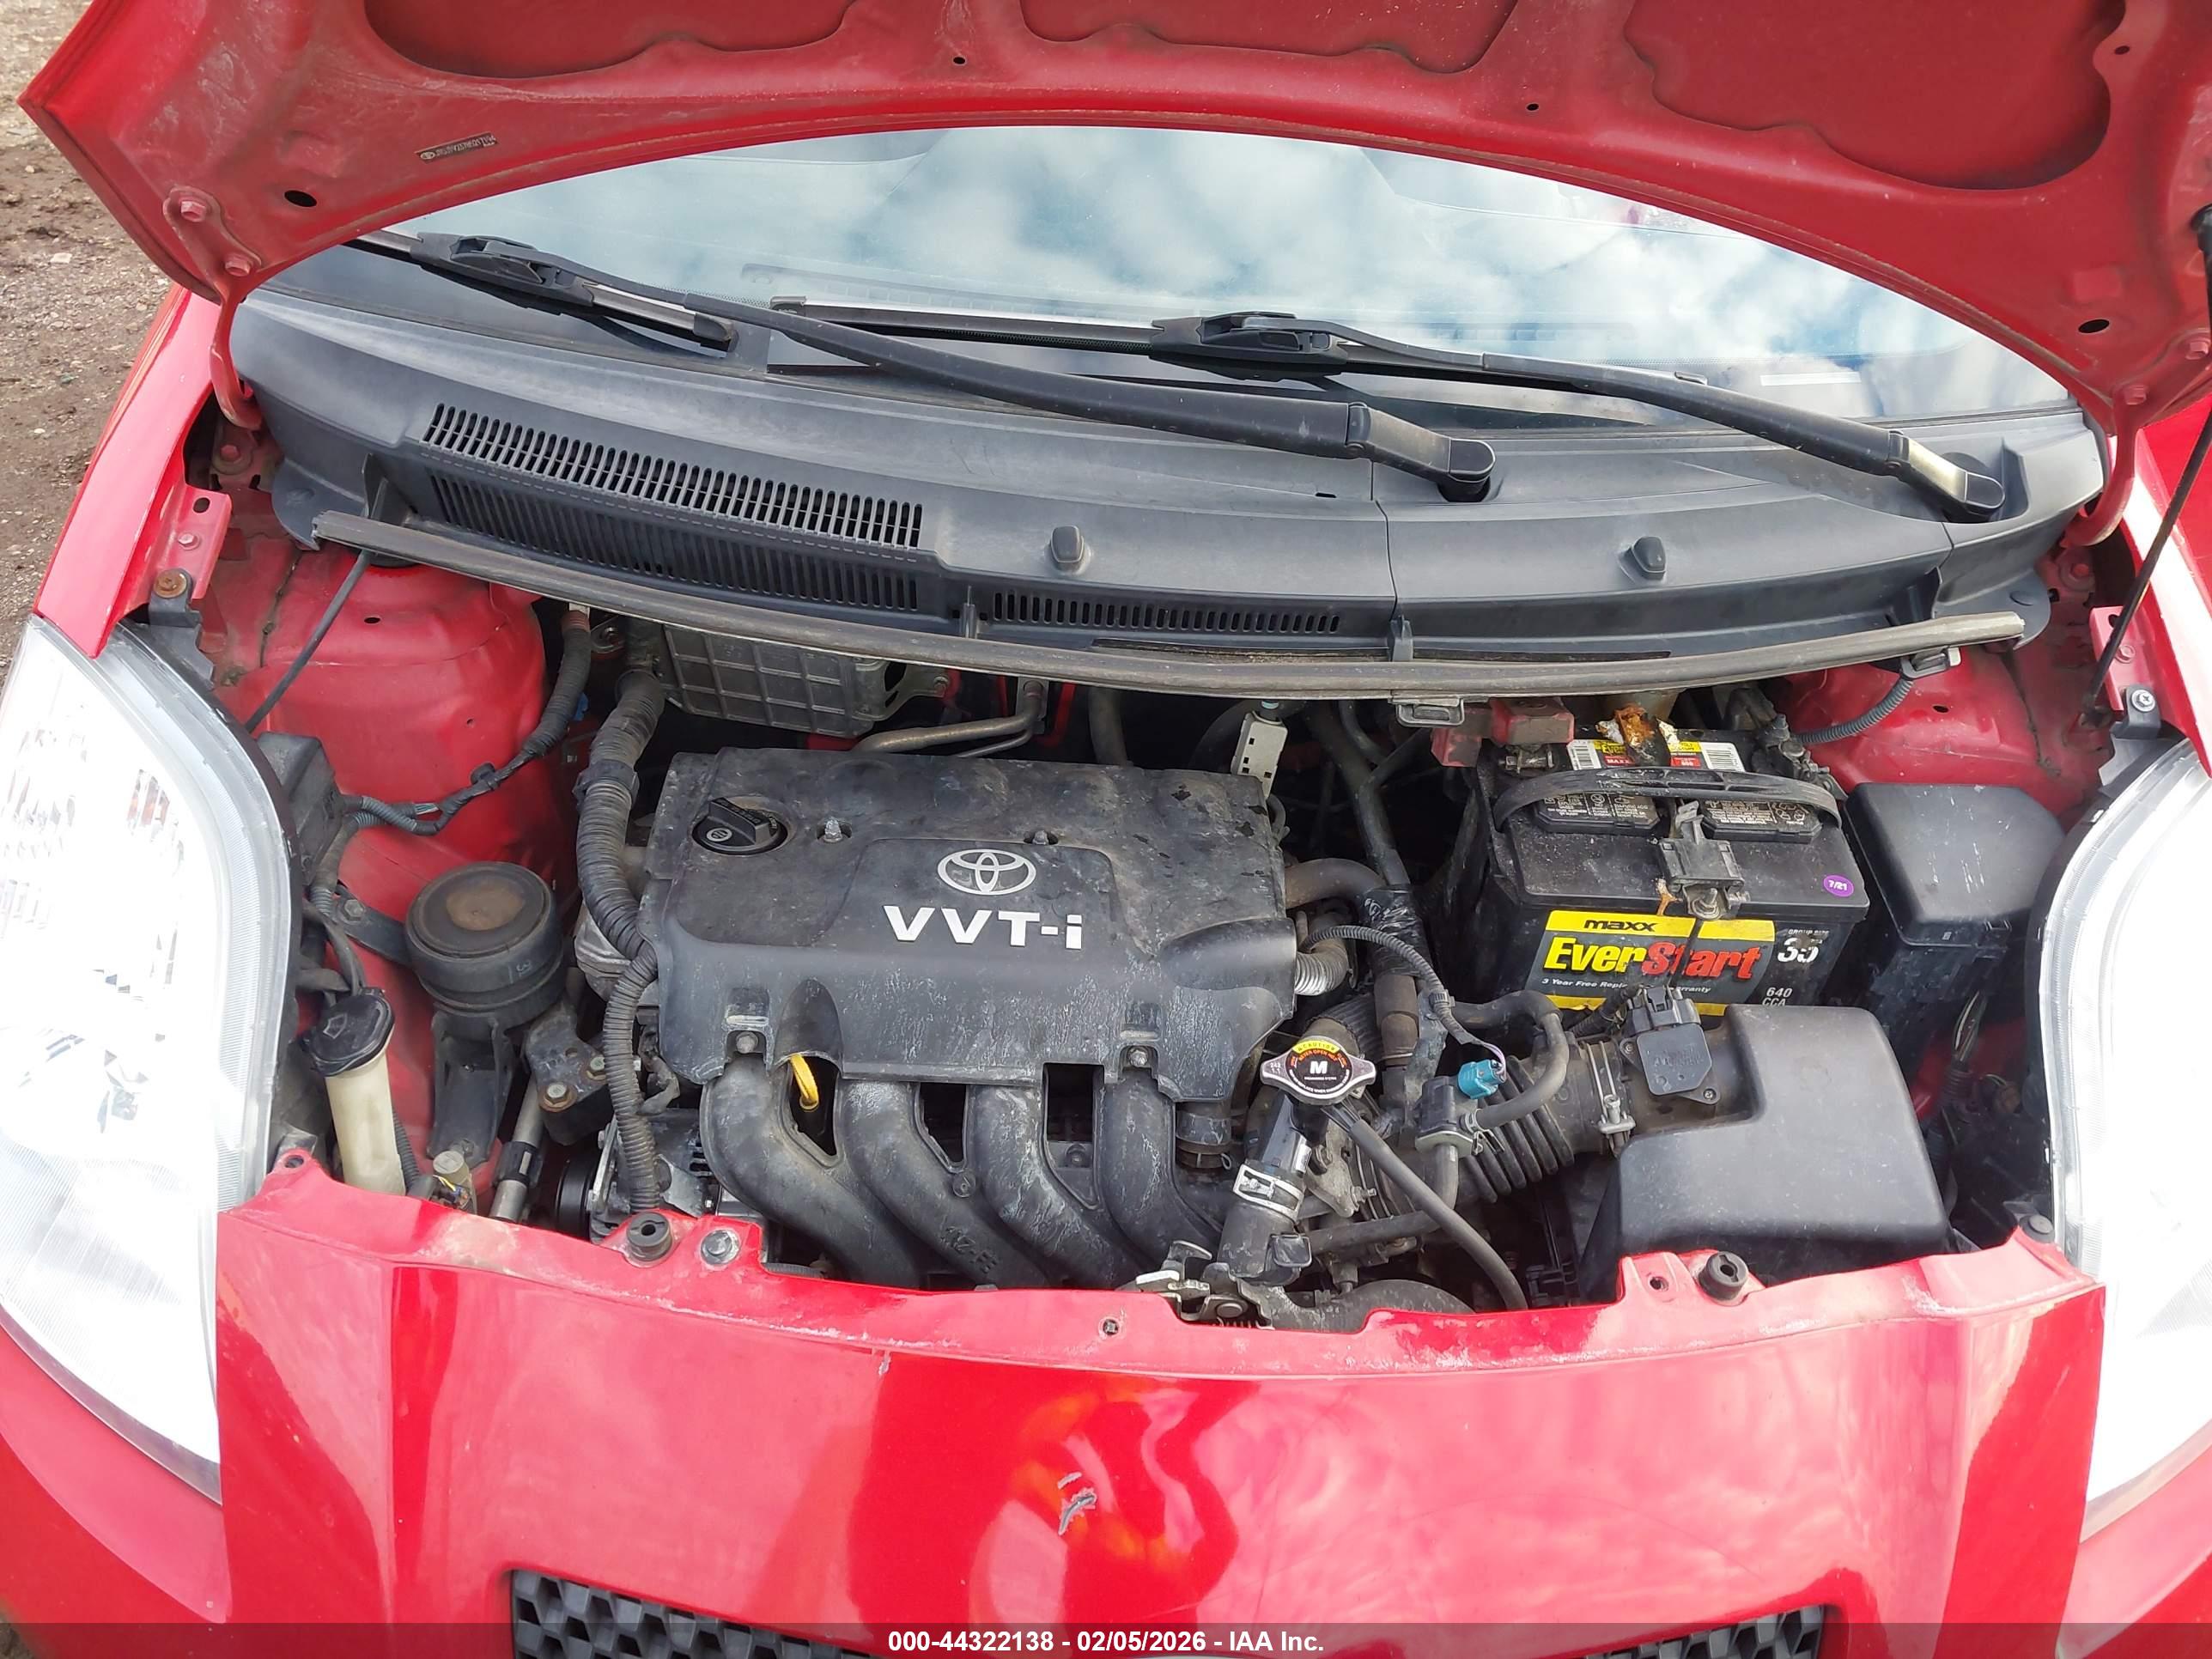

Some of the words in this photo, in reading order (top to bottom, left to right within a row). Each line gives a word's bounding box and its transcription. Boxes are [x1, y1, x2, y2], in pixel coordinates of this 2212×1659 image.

[1828, 879, 1848, 891] 7/21
[882, 905, 1083, 950] VVT-i
[1585, 919, 1658, 933] maxx
[1552, 978, 1573, 987] Year
[1765, 987, 1793, 998] 640
[1761, 997, 1787, 1007] CCA
[1310, 1060, 1328, 1074] M
